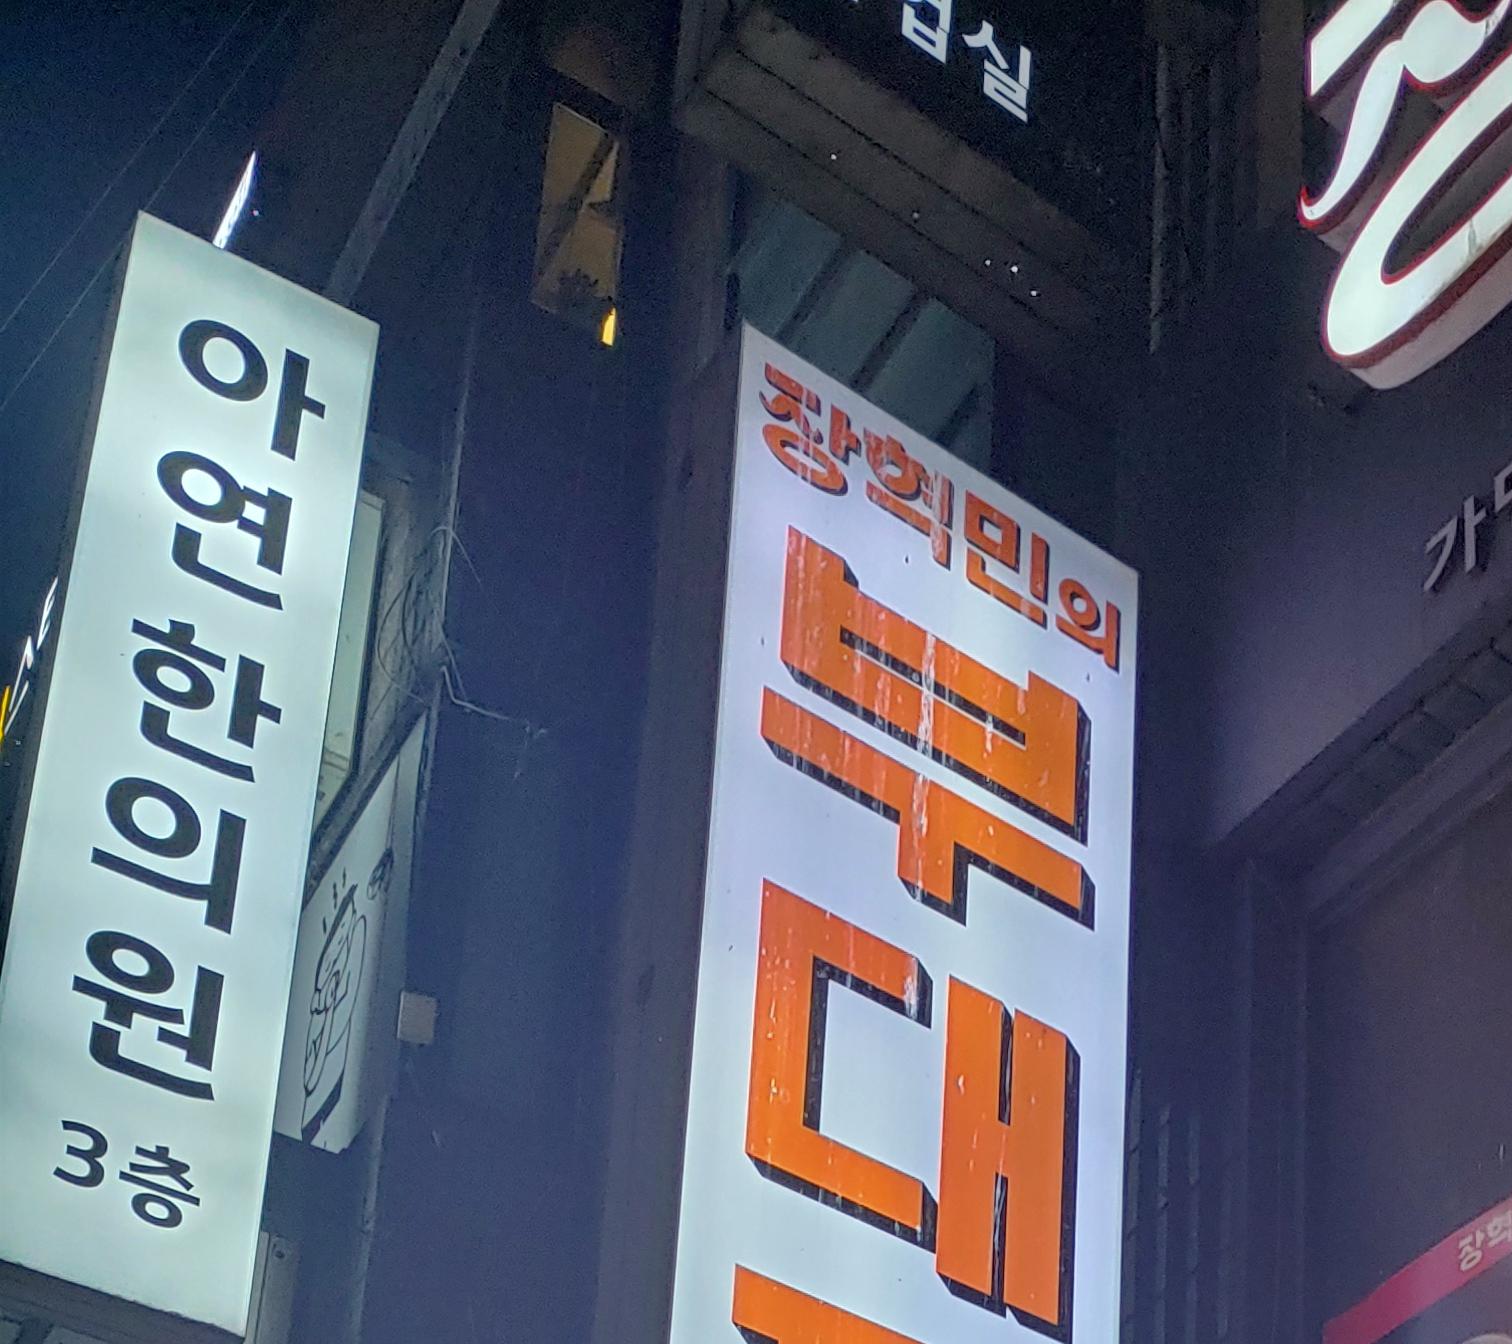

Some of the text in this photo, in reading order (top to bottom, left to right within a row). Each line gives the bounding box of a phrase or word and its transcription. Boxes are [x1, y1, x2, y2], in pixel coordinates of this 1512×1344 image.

[758, 361, 1120, 673] 장혁민의
[72, 319, 326, 1101] 아연한의원
[53, 1120, 200, 1229] 3층
